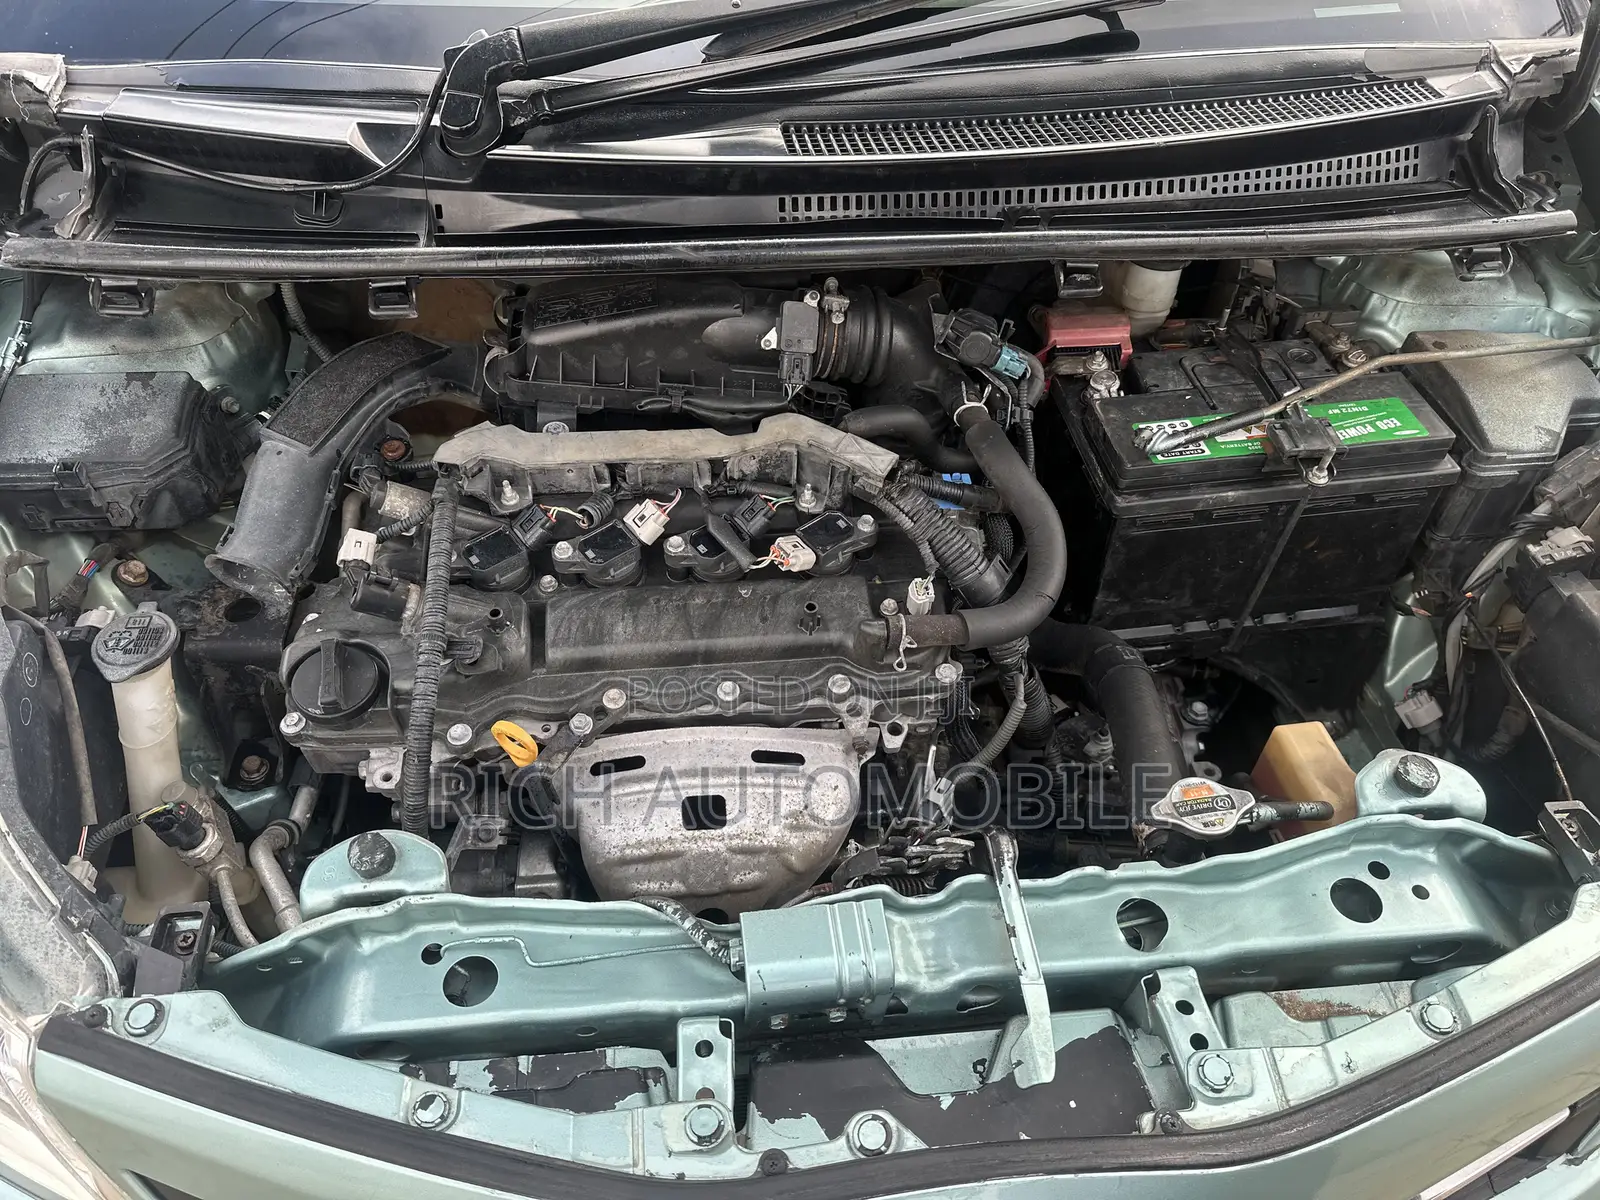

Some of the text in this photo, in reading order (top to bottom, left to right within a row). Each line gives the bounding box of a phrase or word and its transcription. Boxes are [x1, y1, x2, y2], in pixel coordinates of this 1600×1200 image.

[1375, 417, 1402, 430] ECO
[1336, 423, 1376, 440] POWE
[1181, 448, 1203, 456] START
[1180, 802, 1213, 812] DRIVE JOY
